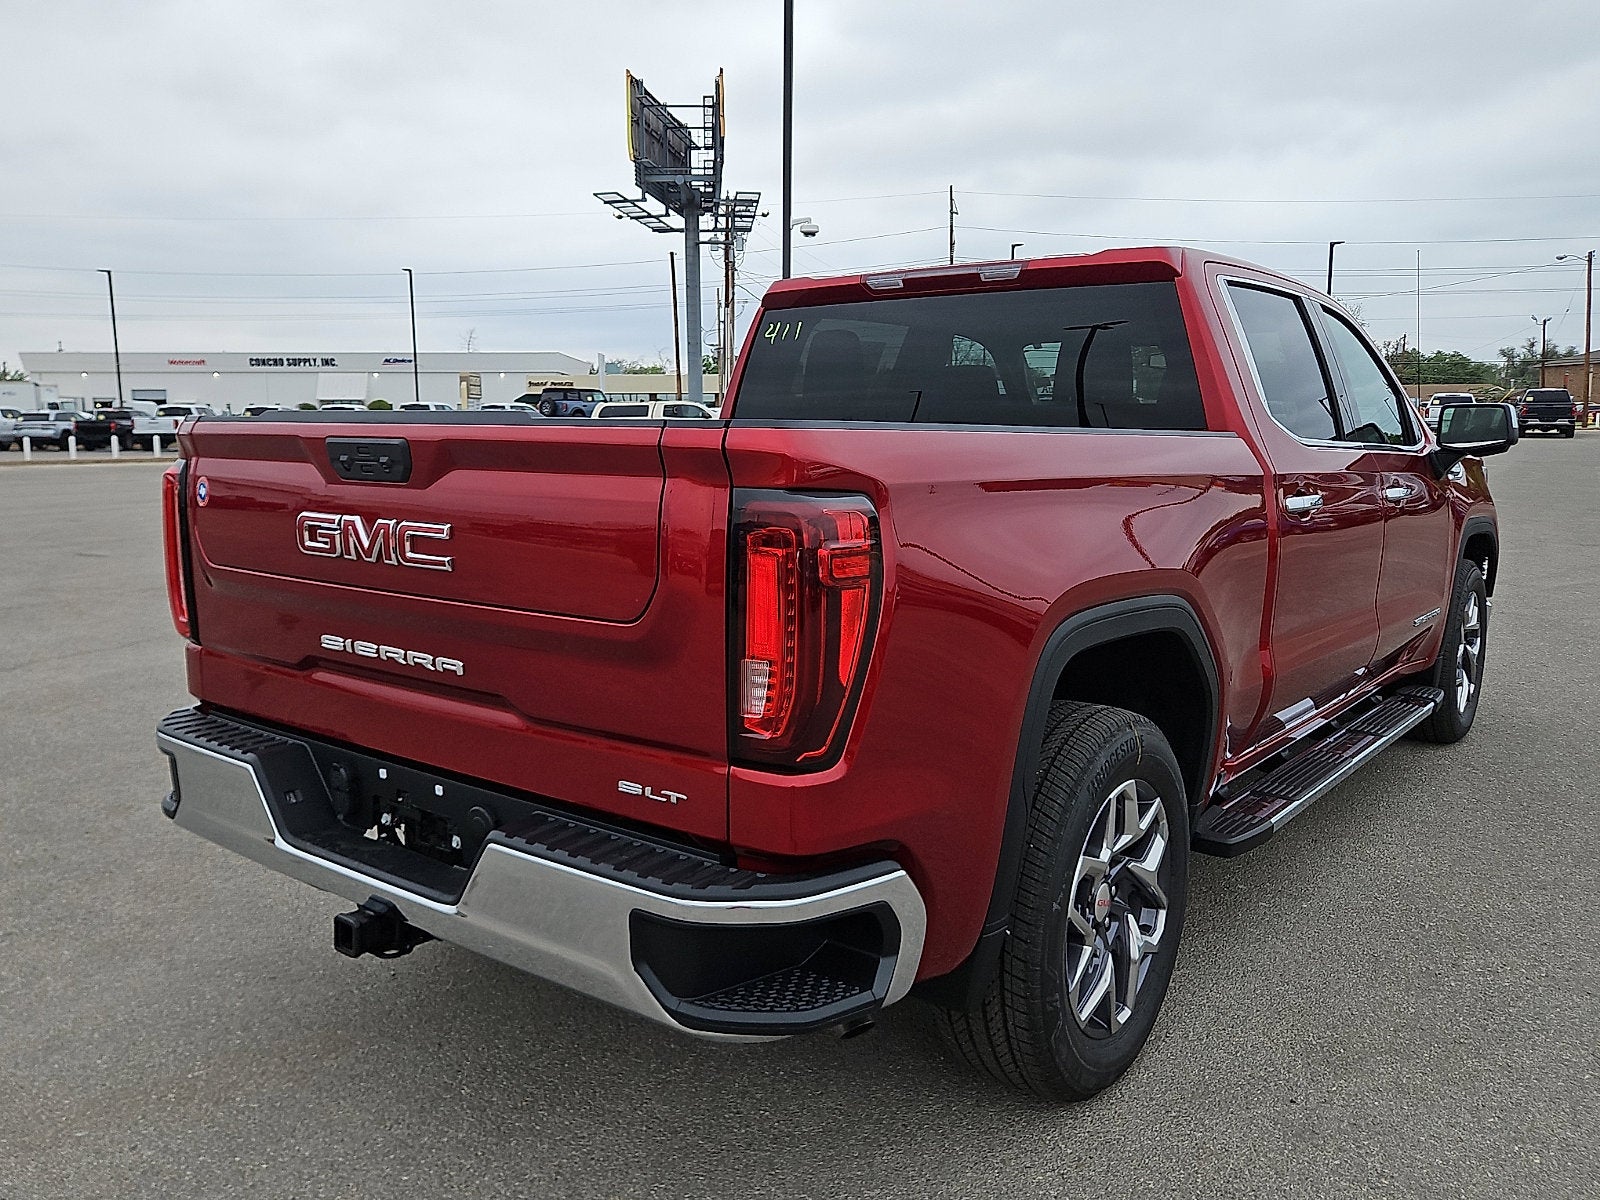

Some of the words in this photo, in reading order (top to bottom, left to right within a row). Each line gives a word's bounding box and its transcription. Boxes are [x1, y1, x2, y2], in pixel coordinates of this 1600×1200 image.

[765, 321, 803, 345] 411
[249, 357, 285, 368] CONCHO
[285, 357, 320, 368] SUPPLY,
[320, 357, 338, 368] INC.
[296, 511, 454, 572] GMC
[320, 633, 465, 676] SIERRA
[617, 780, 688, 804] SLT
